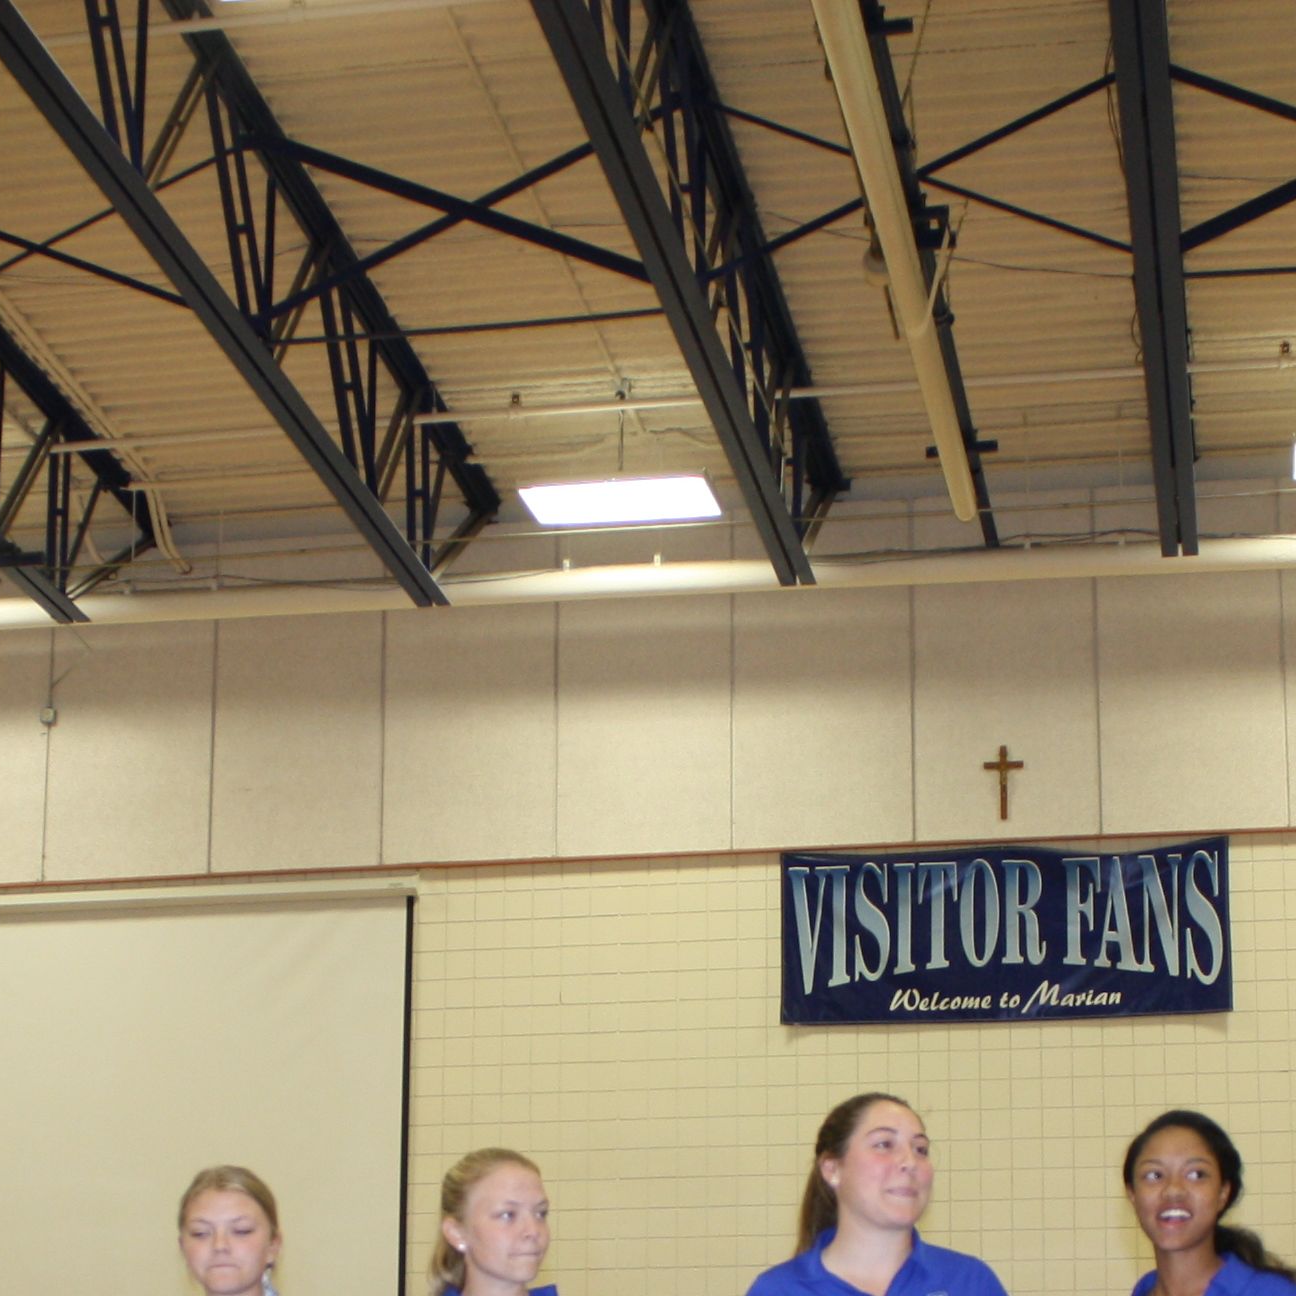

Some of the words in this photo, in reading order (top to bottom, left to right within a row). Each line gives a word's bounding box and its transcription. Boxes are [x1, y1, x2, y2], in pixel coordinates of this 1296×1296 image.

[788, 856, 1047, 996] VISITOR
[1061, 849, 1225, 987] FANS
[889, 987, 993, 1012] Welcome
[1000, 991, 1021, 1009] to
[1020, 980, 1123, 1013] Marian
